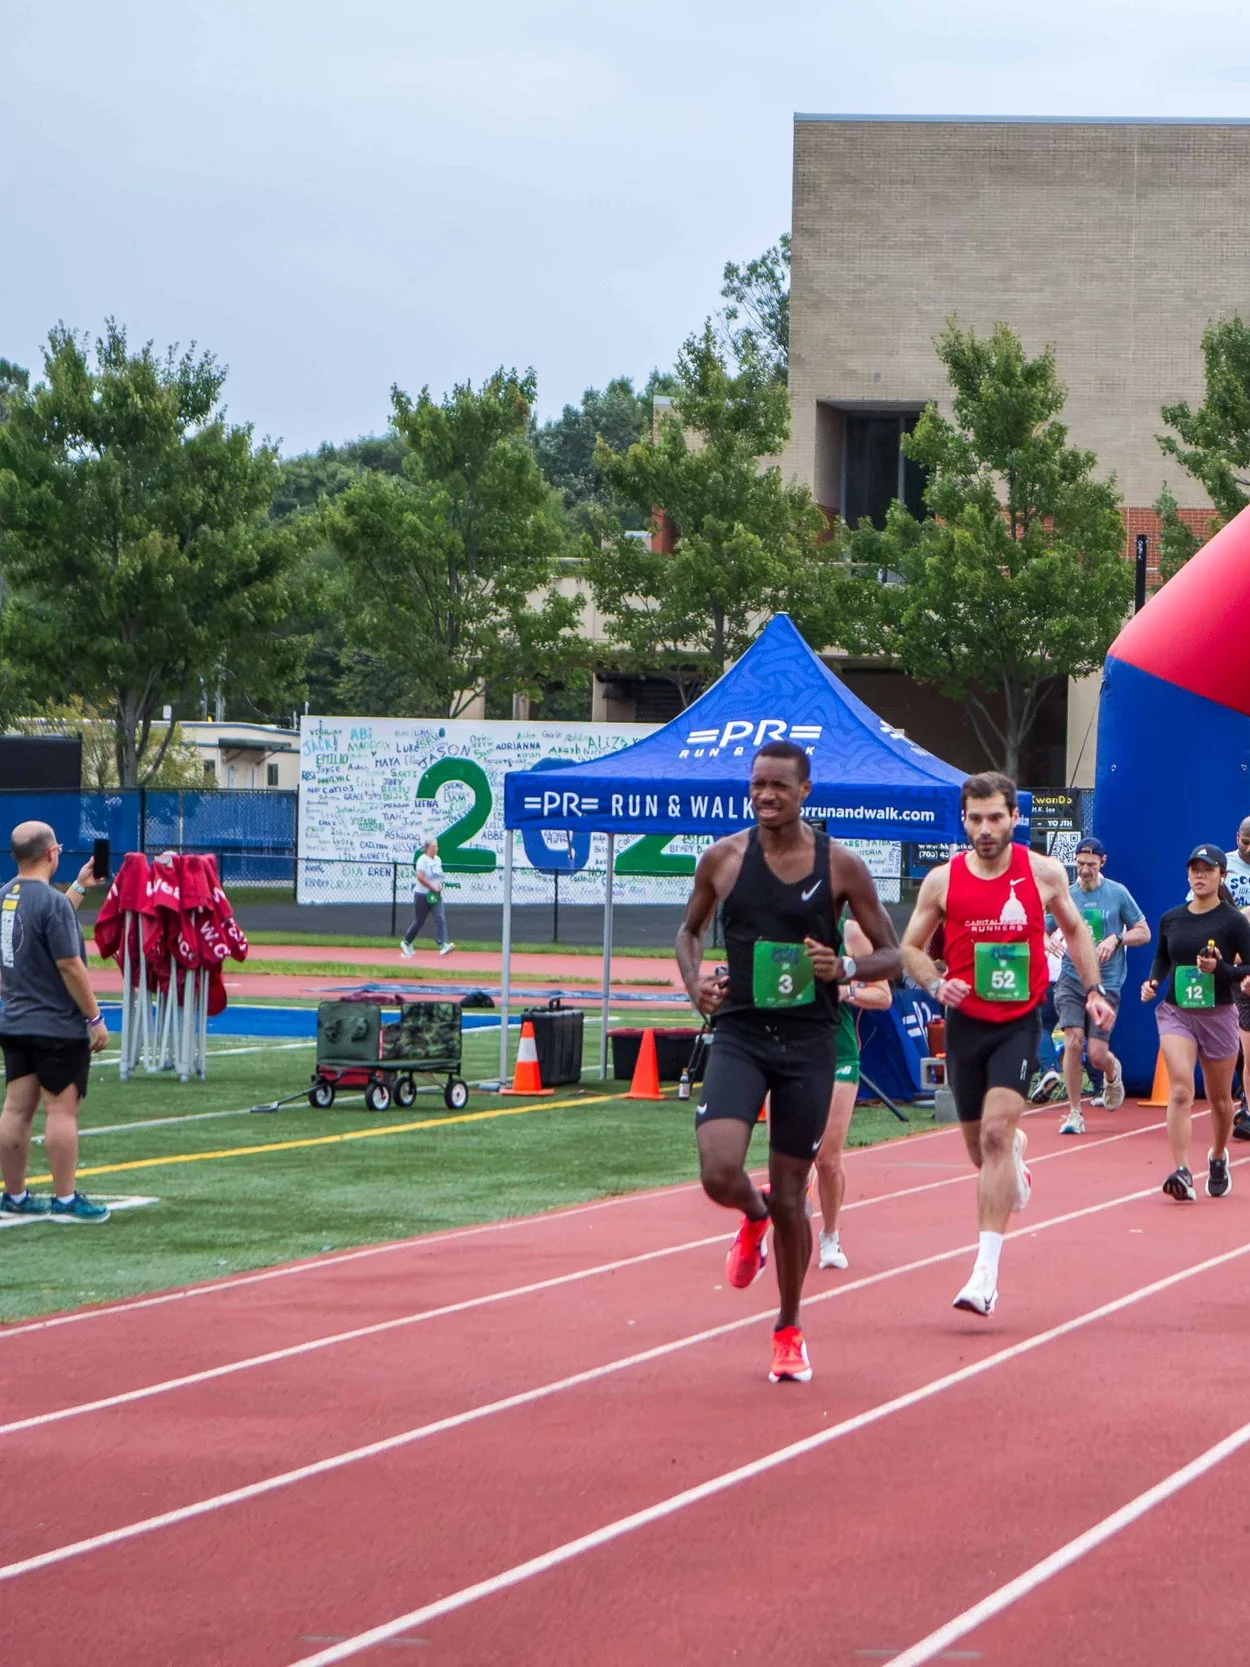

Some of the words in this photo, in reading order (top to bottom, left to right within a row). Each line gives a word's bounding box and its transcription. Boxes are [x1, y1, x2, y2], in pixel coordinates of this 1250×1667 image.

[496, 741, 541, 751] ADRIANNA
[679, 747, 719, 758] RUN
[418, 743, 471, 769] JASON
[611, 794, 658, 817] RUN
[668, 795, 681, 818] &
[691, 796, 754, 819] WALK
[778, 974, 793, 994] 3
[991, 970, 1016, 989] 52
[1186, 985, 1203, 999] 12
